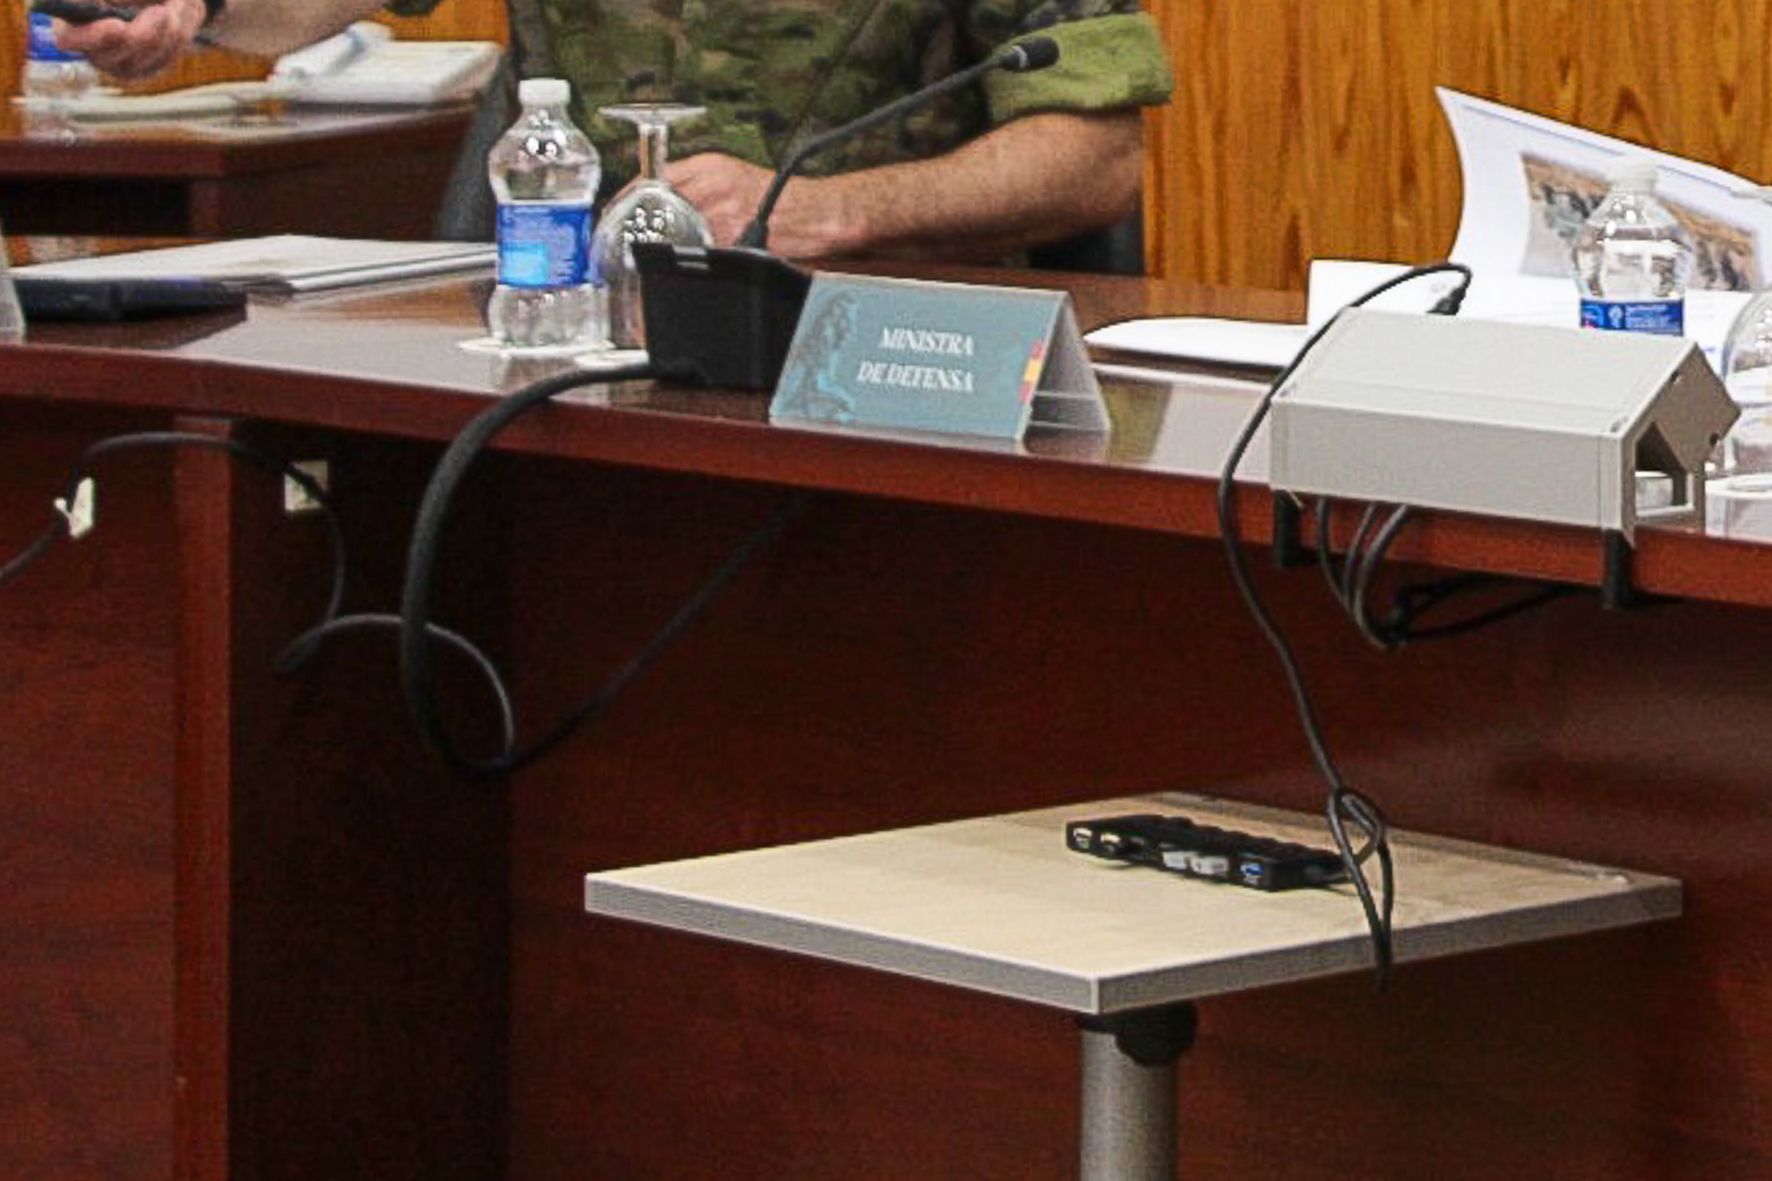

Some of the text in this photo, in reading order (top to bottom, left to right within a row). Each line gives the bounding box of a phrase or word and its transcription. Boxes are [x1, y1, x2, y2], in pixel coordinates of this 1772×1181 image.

[879, 327, 975, 356] MINISTRA
[857, 361, 975, 392] DE DEFENSA
